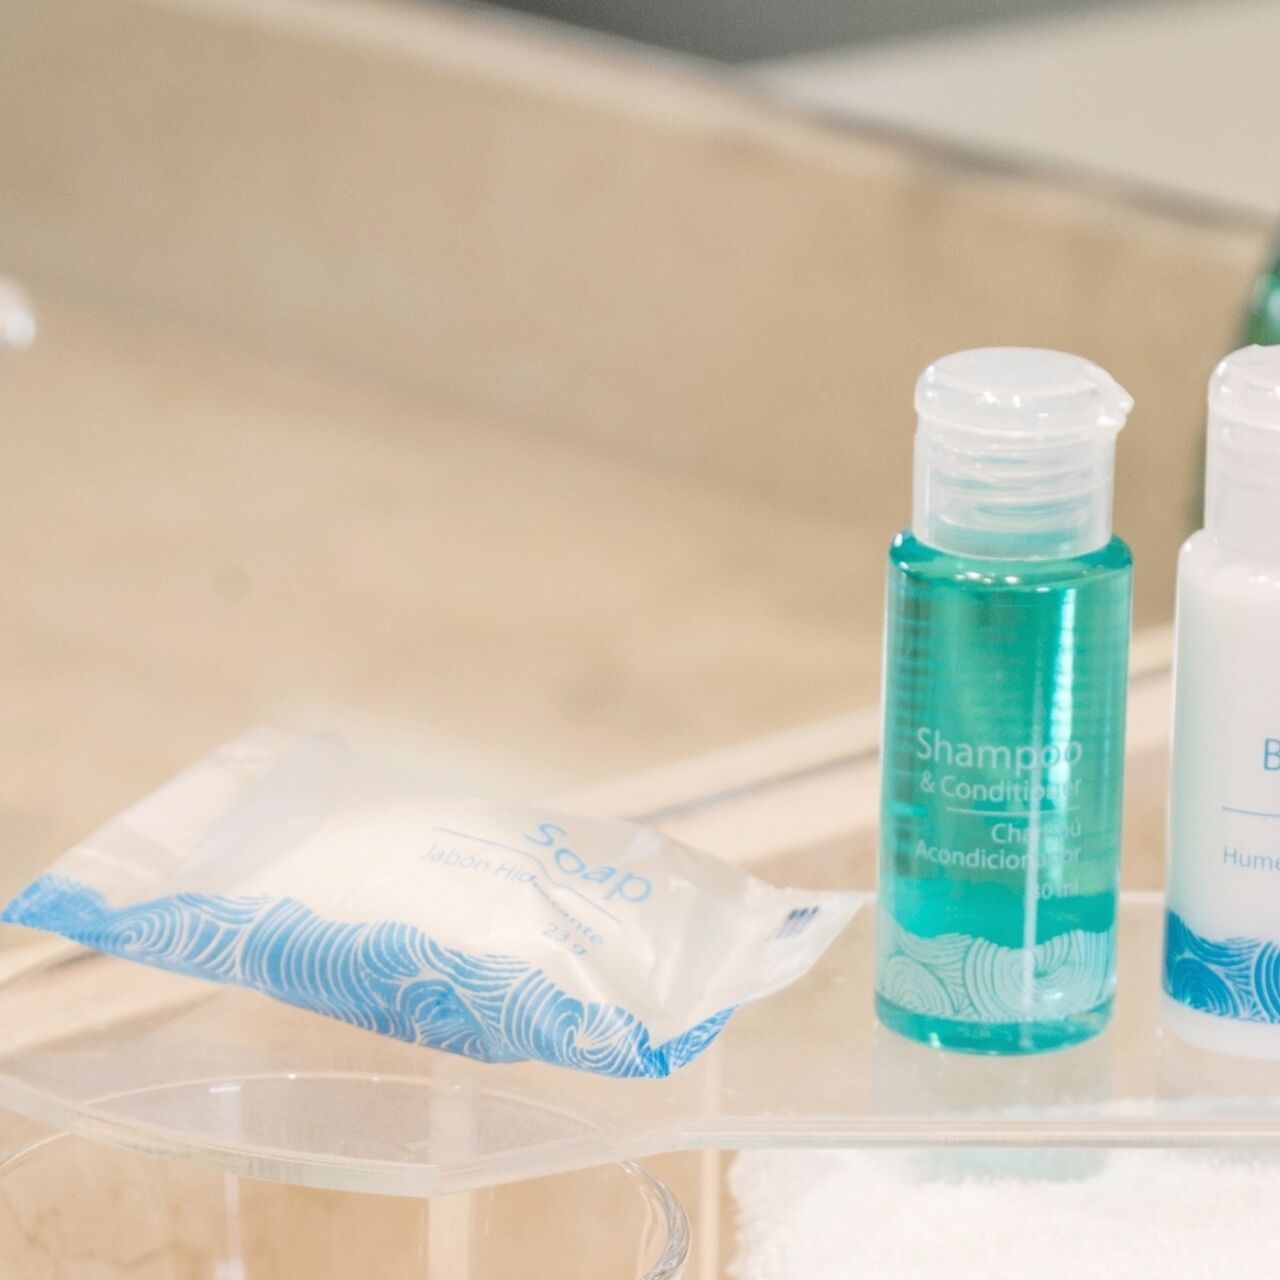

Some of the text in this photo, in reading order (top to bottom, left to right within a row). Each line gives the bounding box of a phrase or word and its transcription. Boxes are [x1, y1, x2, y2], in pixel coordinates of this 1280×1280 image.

[916, 727, 1083, 777] Shampoo
[921, 769, 935, 793] &
[991, 819, 1082, 844] Chaú
[416, 843, 490, 873] Jabón
[522, 822, 654, 903] Soap
